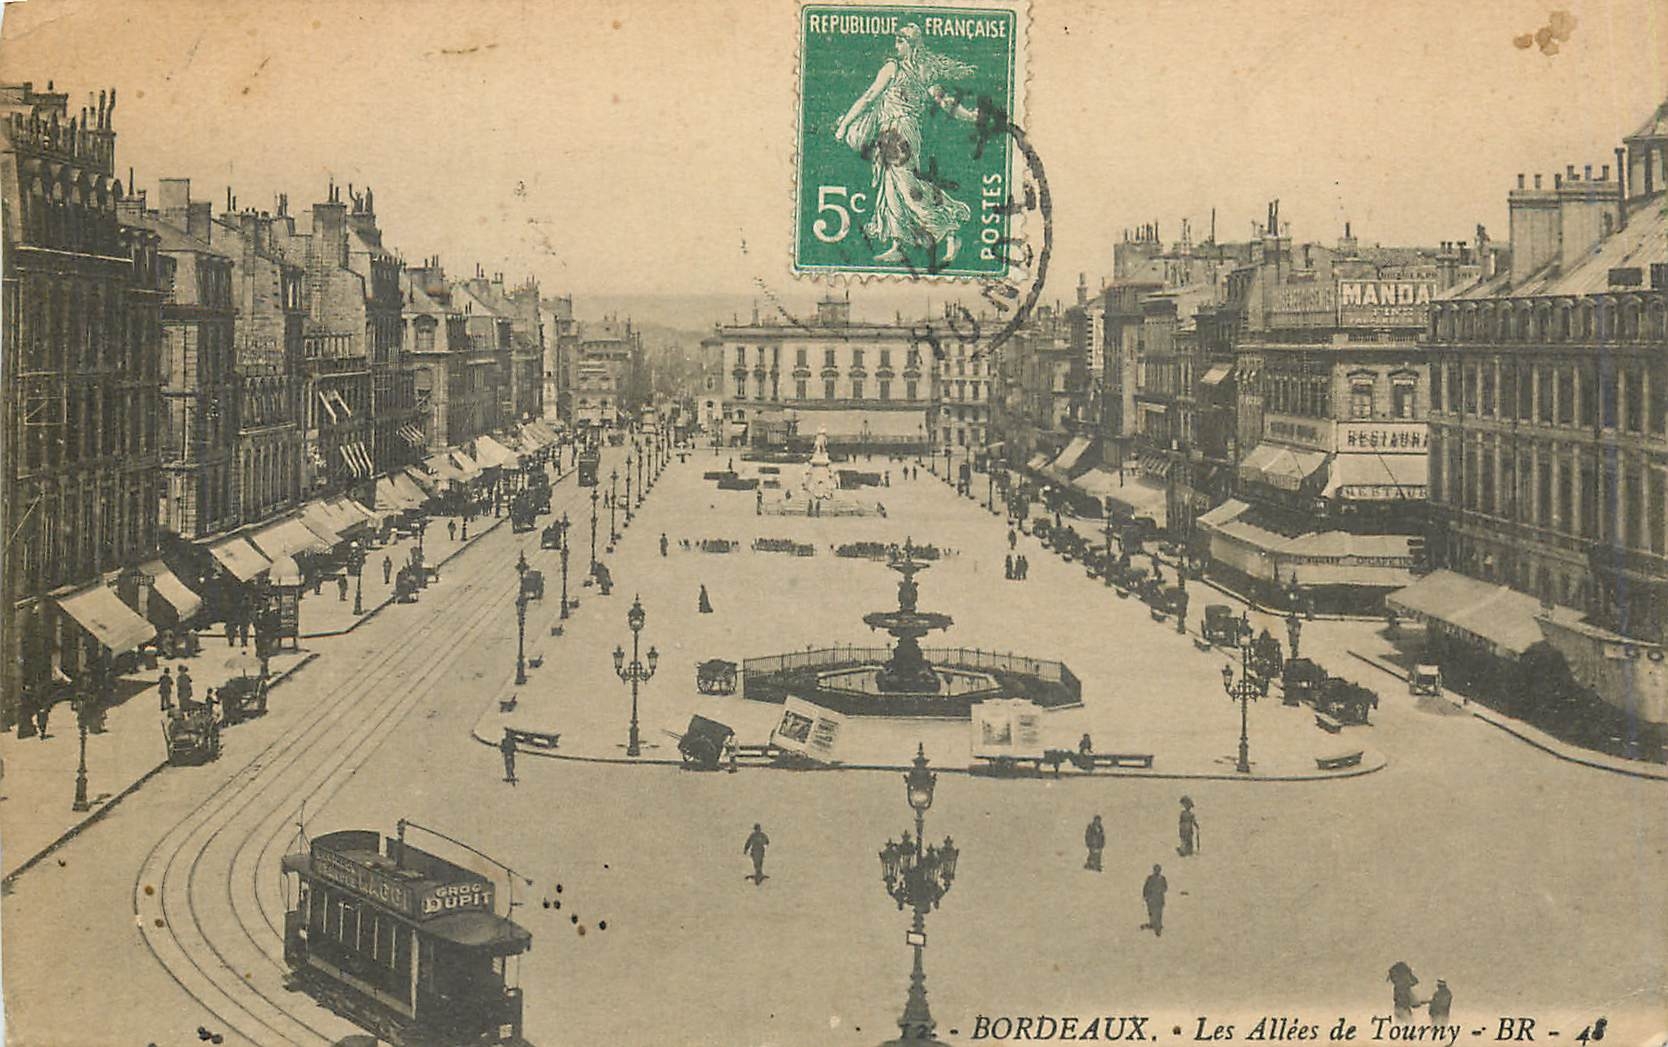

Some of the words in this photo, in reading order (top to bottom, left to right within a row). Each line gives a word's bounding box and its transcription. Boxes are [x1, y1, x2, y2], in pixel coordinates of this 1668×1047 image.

[925, 17, 1007, 40] FRANÇAISE
[980, 173, 1001, 260] POSTES
[1343, 283, 1437, 305] MANDA
